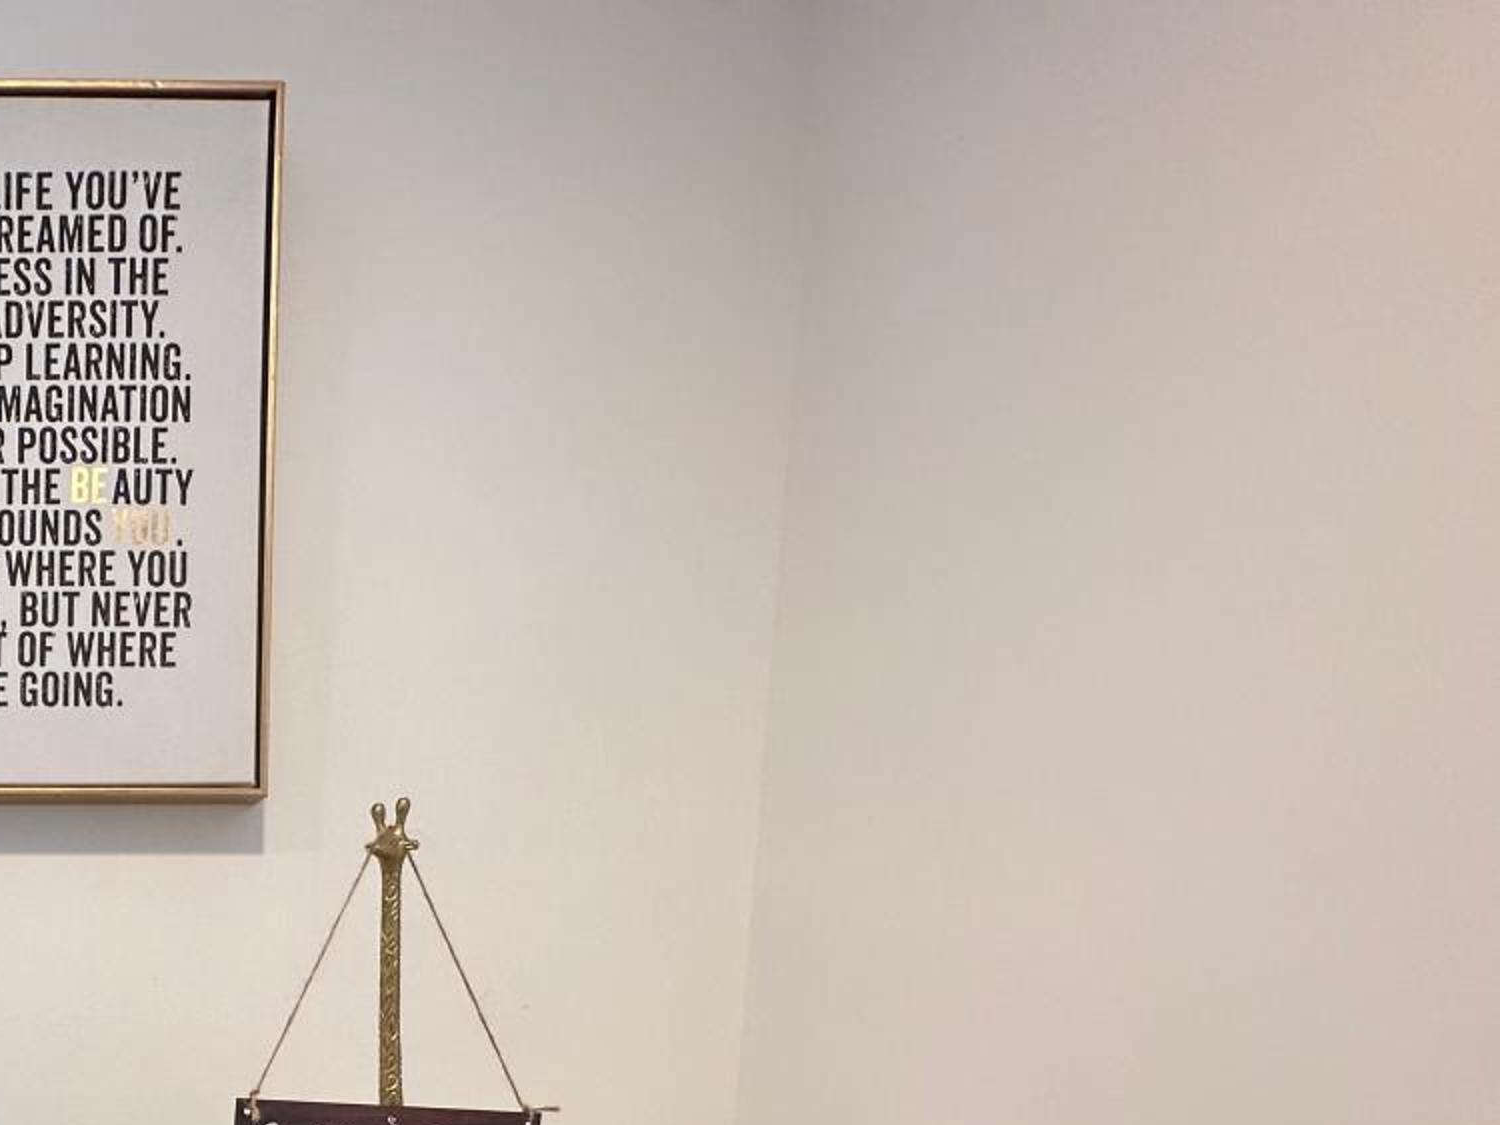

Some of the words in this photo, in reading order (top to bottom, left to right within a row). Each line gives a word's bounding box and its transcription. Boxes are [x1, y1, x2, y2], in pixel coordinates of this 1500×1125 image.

[139, 213, 183, 253] OF.
[65, 256, 96, 296] IN
[107, 256, 169, 296] THE
[25, 341, 191, 380] LEARNING.
[17, 426, 177, 464] POSSIBLE.
[0, 467, 61, 505] THE
[70, 467, 194, 505] BEAUTY
[112, 508, 183, 546] YOU.
[5, 549, 116, 587] WHERE
[127, 549, 188, 587] YOU
[20, 590, 81, 628] BUT
[91, 590, 192, 628] NEVER
[17, 630, 56, 667] OF
[66, 630, 177, 667] WHERE
[19, 671, 123, 707] GOING.
